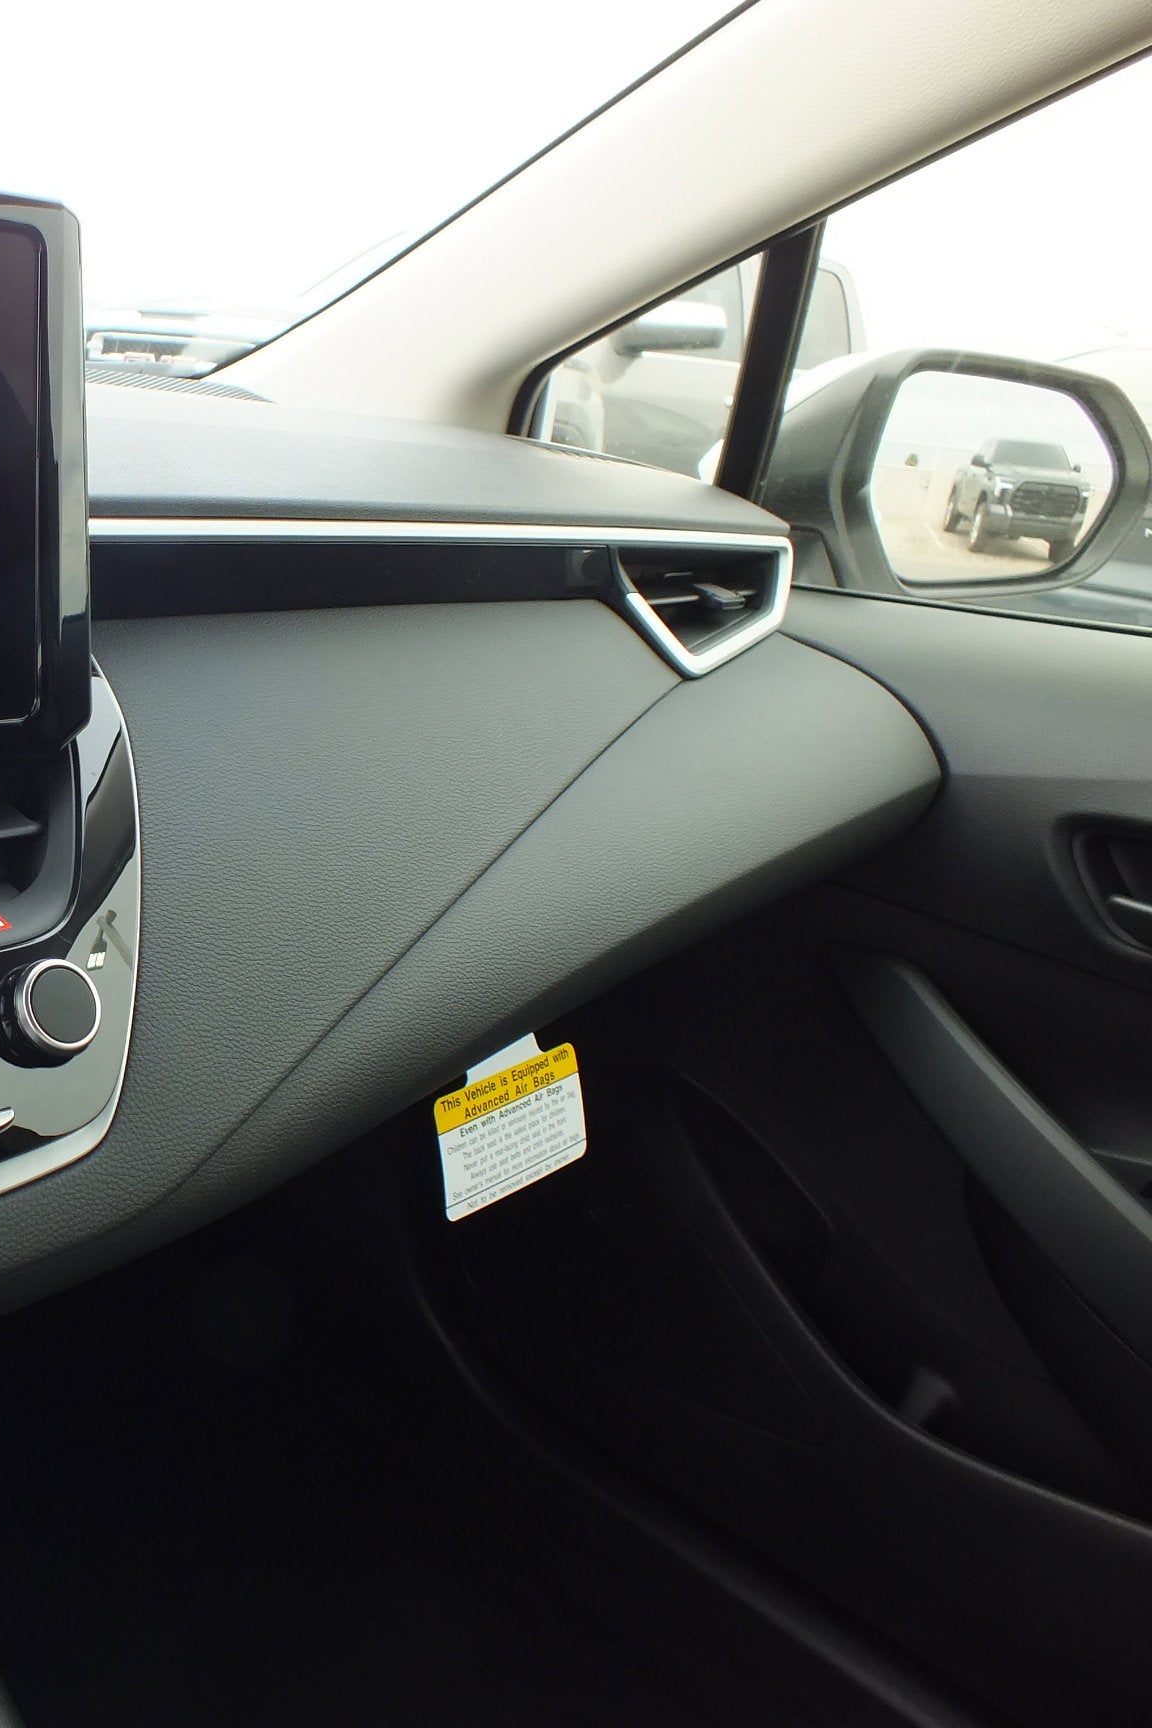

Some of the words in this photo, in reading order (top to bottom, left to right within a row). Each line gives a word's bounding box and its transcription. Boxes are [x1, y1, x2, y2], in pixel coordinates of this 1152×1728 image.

[440, 1095, 461, 1112] This
[464, 1081, 497, 1101] Vehicle
[500, 1075, 508, 1088] is
[511, 1058, 550, 1081] Equipped
[553, 1049, 569, 1063] with
[464, 1090, 510, 1120] Advanced
[515, 1082, 528, 1097] Air
[533, 1070, 555, 1088] Bags
[460, 1124, 478, 1138] Even
[481, 1115, 496, 1127] with
[499, 1099, 532, 1120] Advanced
[534, 1093, 543, 1102] Air
[546, 1084, 563, 1097] Bags
